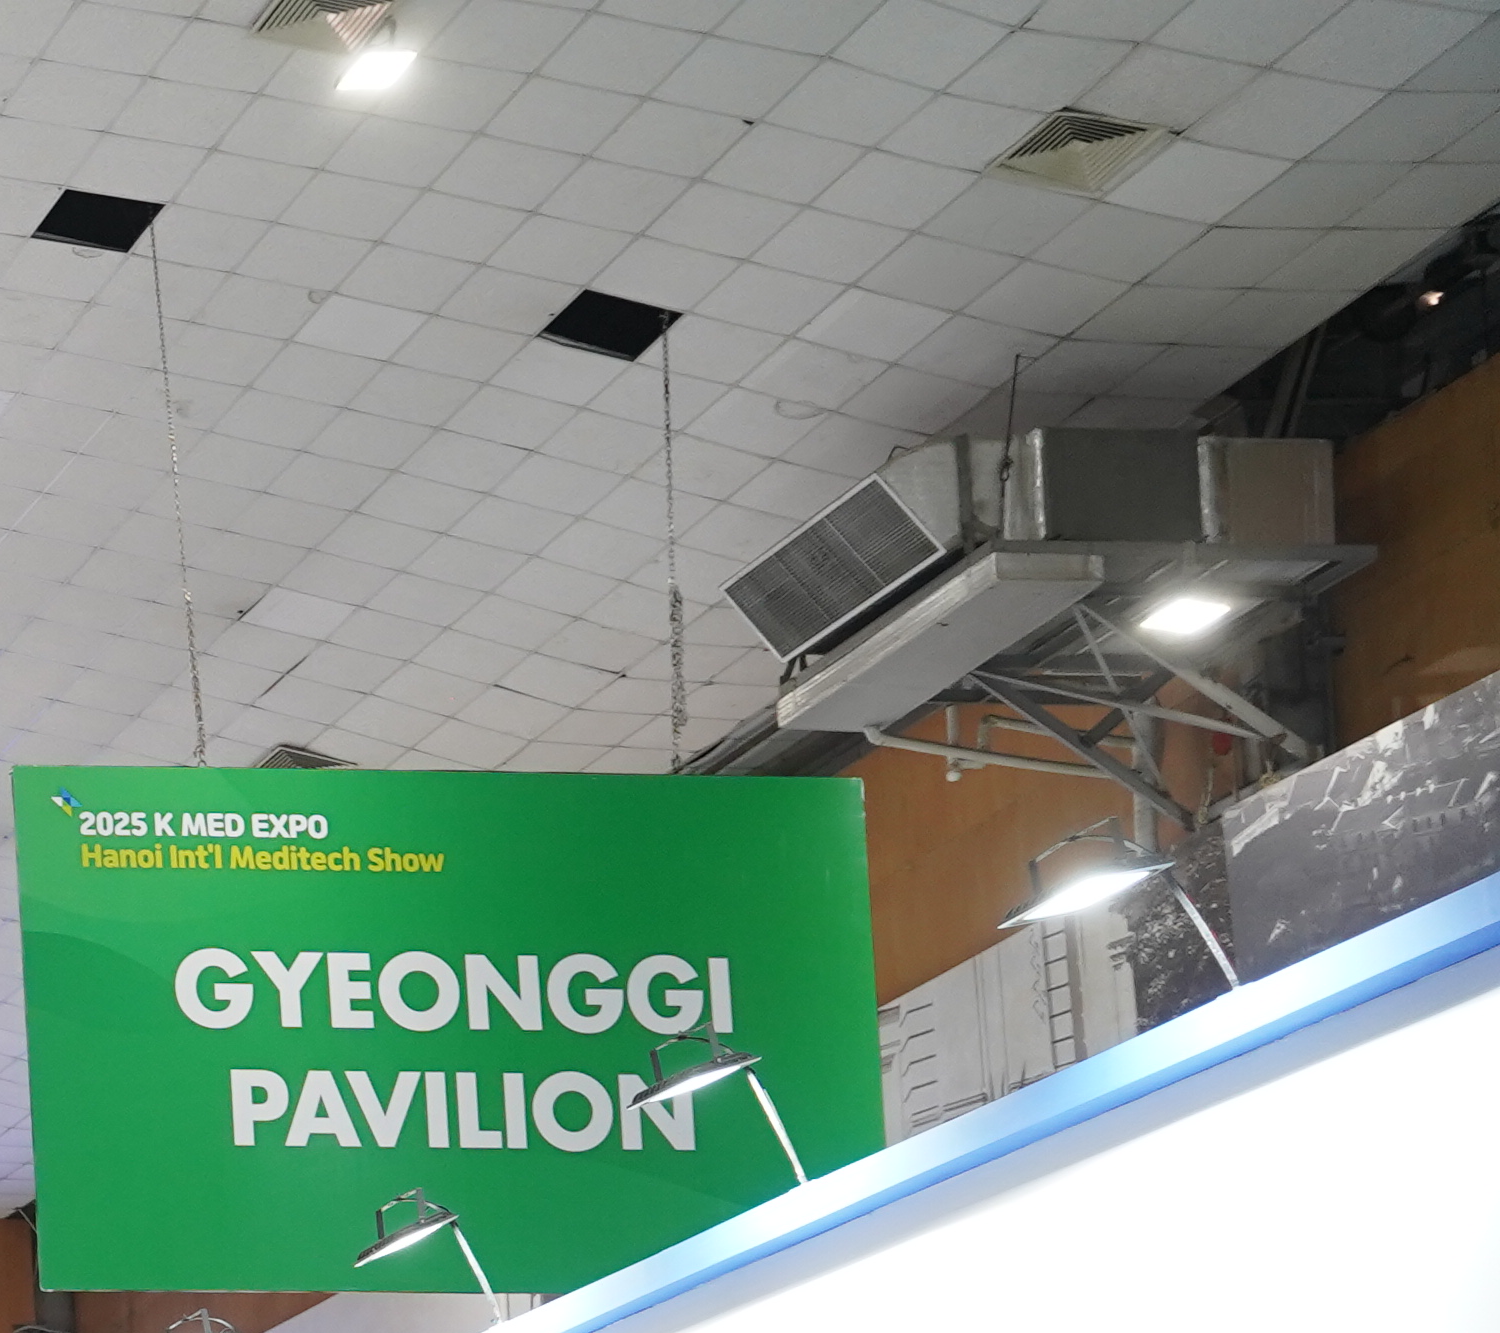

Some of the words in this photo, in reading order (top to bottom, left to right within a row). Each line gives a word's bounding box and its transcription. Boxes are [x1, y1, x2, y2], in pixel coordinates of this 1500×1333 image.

[79, 811, 148, 837] 2025
[153, 812, 175, 837] K
[181, 812, 244, 838] MED
[251, 813, 329, 839] EXPO
[81, 844, 163, 871] Hanoi
[169, 845, 222, 871] Int'l
[228, 845, 362, 872] Meditech
[367, 846, 444, 873] Show
[173, 946, 734, 1035] GYEONGGI
[229, 1068, 696, 1152] PAVILION
